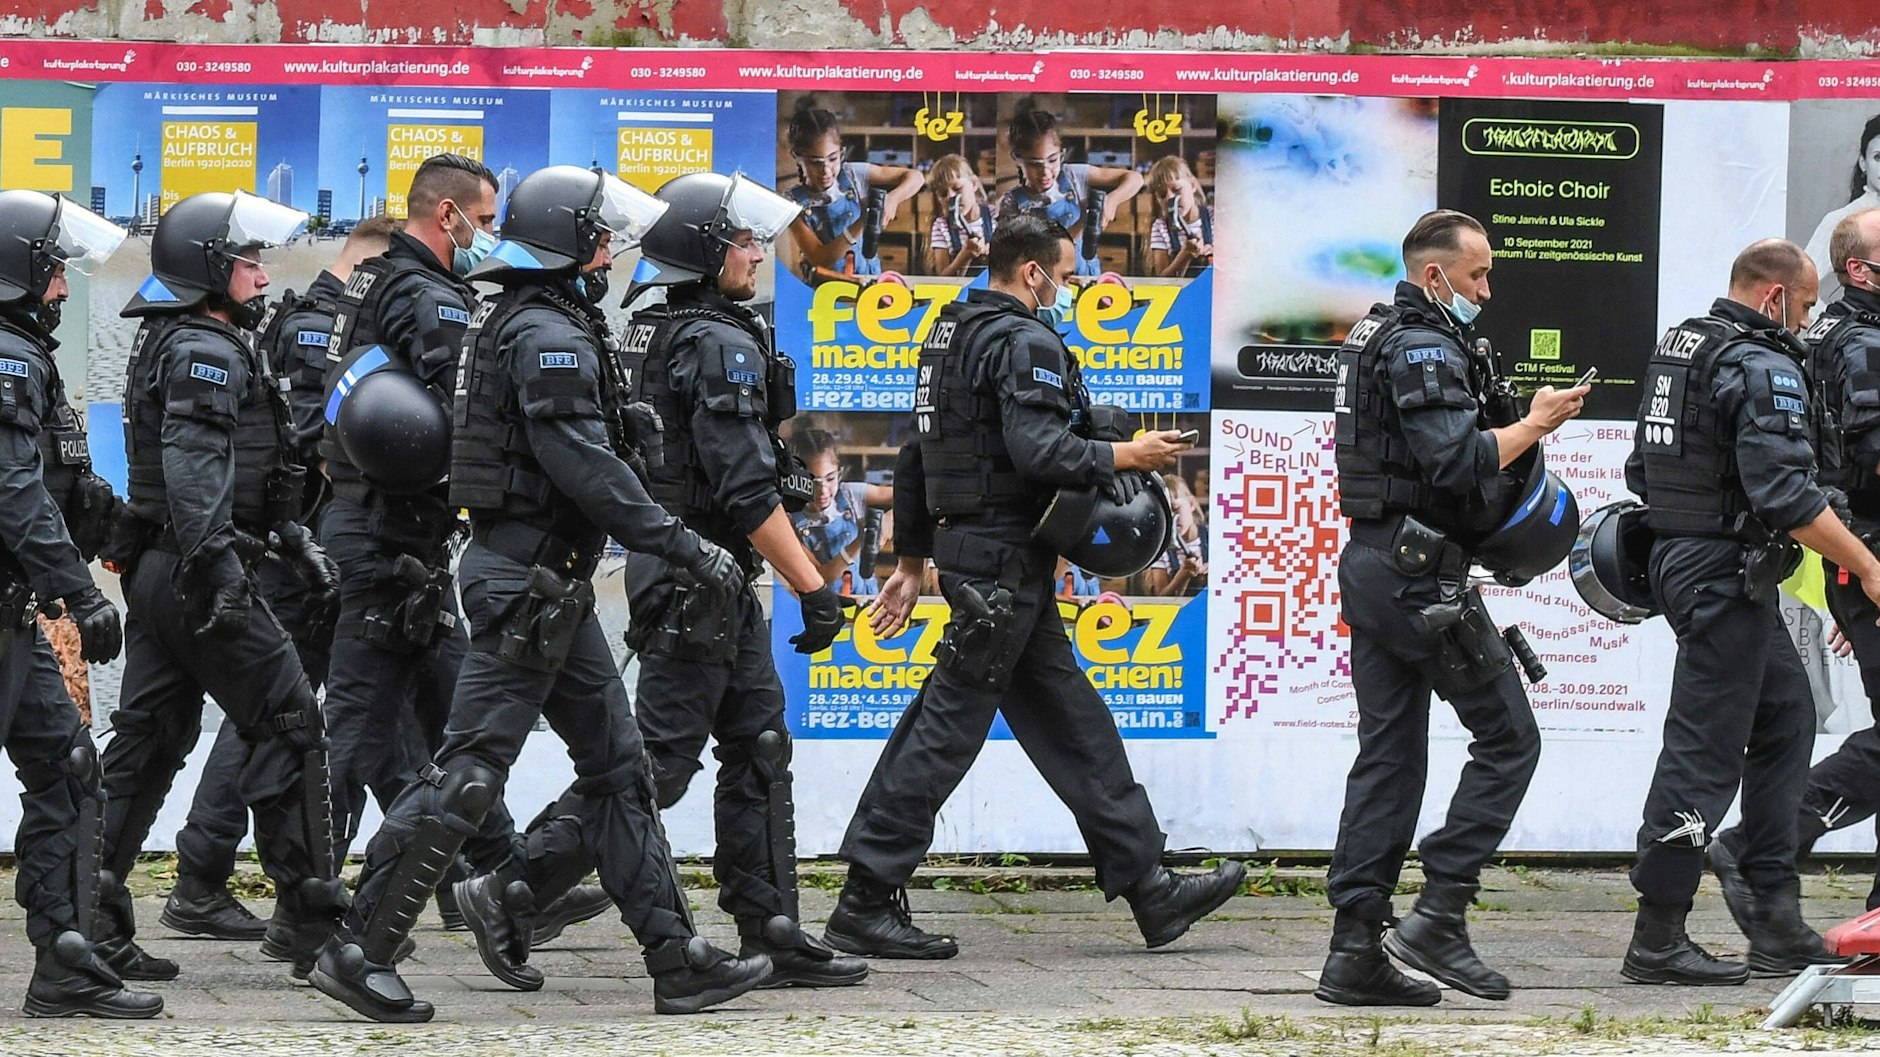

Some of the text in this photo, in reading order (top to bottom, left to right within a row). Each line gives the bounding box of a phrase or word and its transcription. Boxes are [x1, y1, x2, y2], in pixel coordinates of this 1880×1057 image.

[283, 59, 470, 77] www.kulturplakatierung.de
[738, 64, 924, 82] www.kulturplakatierung.de
[1176, 67, 1359, 85] www.kulturplakatierung.de
[1501, 72, 1655, 90] .kulturplakatierung.de
[227, 93, 278, 101] MUSEUM
[452, 97, 504, 105] MUSEUM
[682, 100, 733, 108] MUSEUM
[164, 125, 236, 139] CHAOS &
[390, 128, 463, 143] CHAOS &
[620, 131, 693, 146] CHAOS &
[164, 143, 253, 156] AUFBRUCH
[619, 148, 708, 162] AUFBRUCH
[163, 158, 195, 168] Berlin
[619, 163, 651, 173] Berlin
[163, 190, 179, 200] bis
[1490, 178, 1610, 199] Echoic Choir
[388, 193, 404, 203] bis
[1492, 214, 1516, 224] Stine
[1518, 215, 1548, 225] Janvin
[1559, 216, 1575, 226] Ula
[1576, 217, 1605, 227] Sickle
[1504, 237, 1592, 249] 10 September 2021
[1491, 250, 1643, 262] entrum für zeitgenössische Kunst
[545, 354, 573, 365] BFE
[195, 366, 223, 381] BFE
[1514, 362, 1576, 374] CTM Festival
[732, 371, 754, 383] BFE
[1655, 375, 1672, 396] SN
[1650, 396, 1669, 417] 920
[1221, 418, 1293, 451] SOUND
[1596, 428, 1636, 441] BERLI
[1250, 449, 1320, 473] BERLIN
[1570, 452, 1593, 462] der
[1565, 467, 1607, 479] Musik
[1526, 591, 1551, 606] und
[1554, 597, 1593, 618] zuhör
[1589, 633, 1629, 650] Musik
[1289, 682, 1319, 693] Month
[1321, 680, 1330, 688] of
